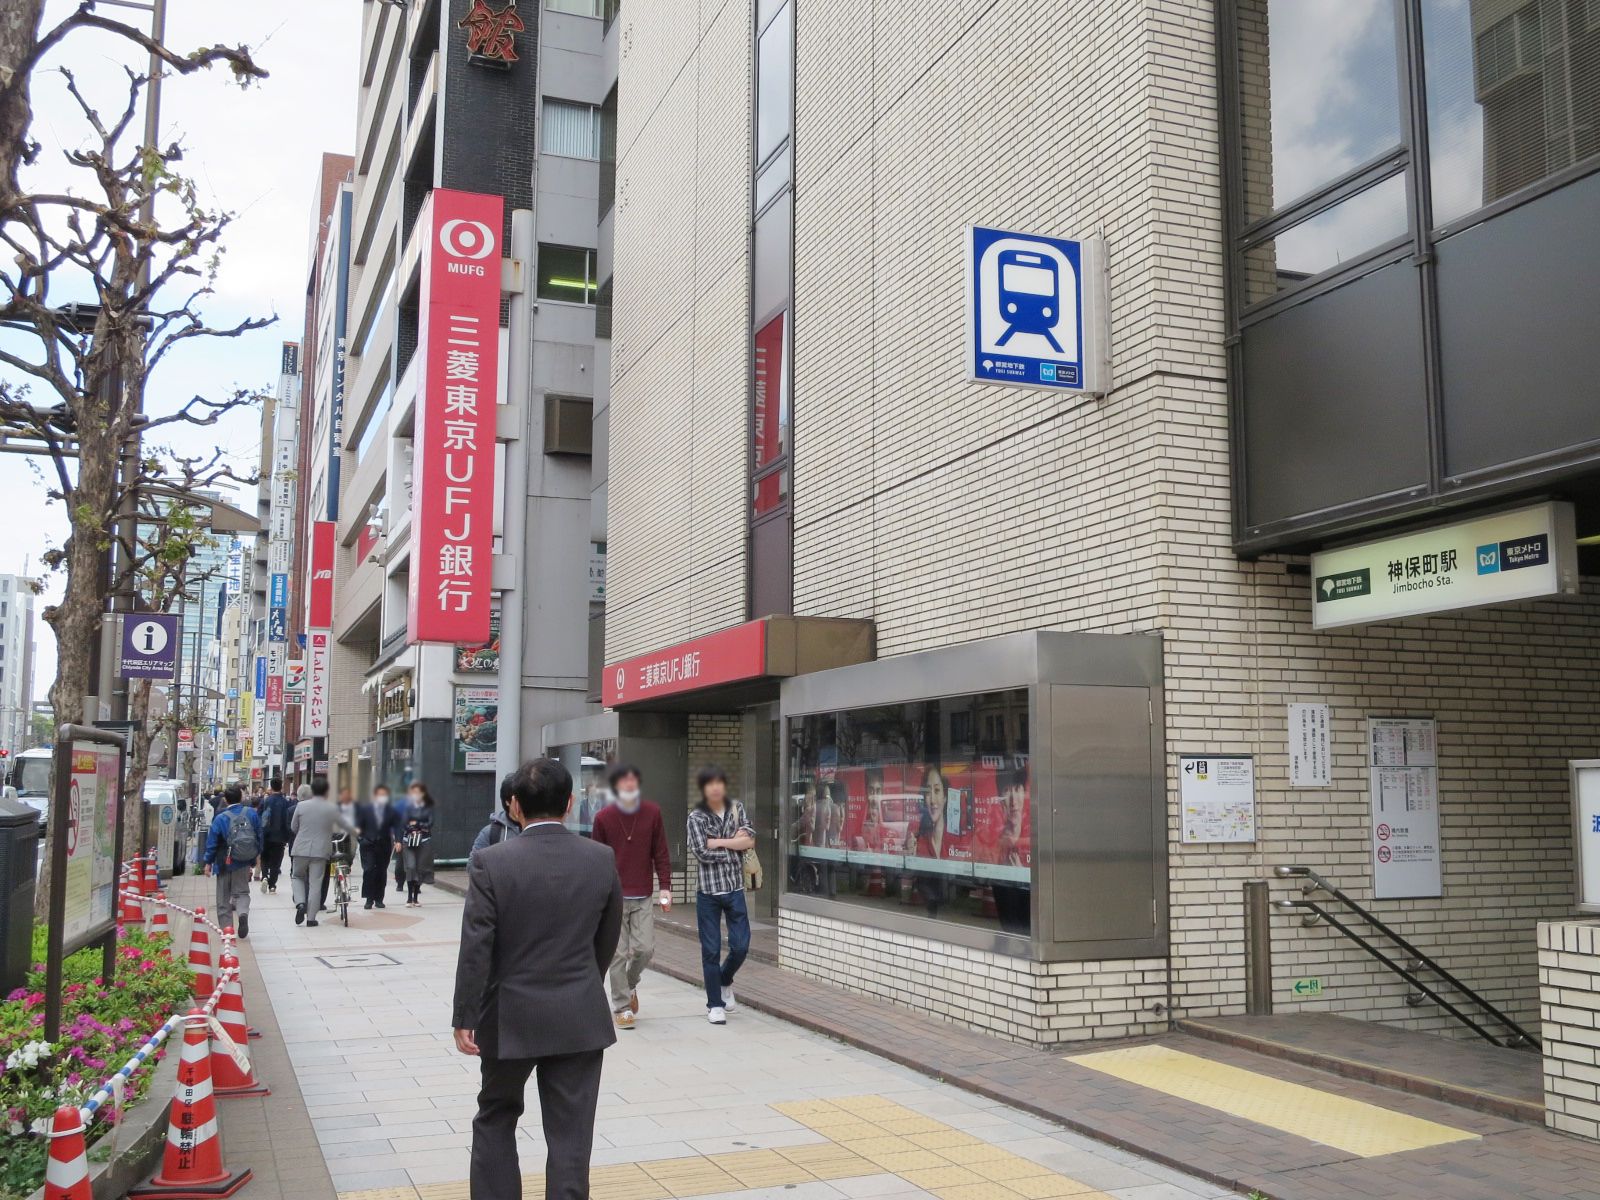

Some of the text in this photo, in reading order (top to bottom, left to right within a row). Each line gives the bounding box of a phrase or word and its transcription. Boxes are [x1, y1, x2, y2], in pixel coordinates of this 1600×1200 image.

[448, 262, 485, 276] MUFG
[437, 314, 480, 613] 三菱東京UFJ銀行
[1506, 543, 1541, 557] 東京メトロ
[313, 569, 332, 580] JTB
[1387, 549, 1458, 582] 神保町駅
[1336, 576, 1362, 587] 都営地下鉄
[1393, 576, 1454, 594] Jimbocho Sta.
[639, 651, 701, 690] 三菱東京UFJ銀行
[184, 1067, 194, 1107] 千代田区
